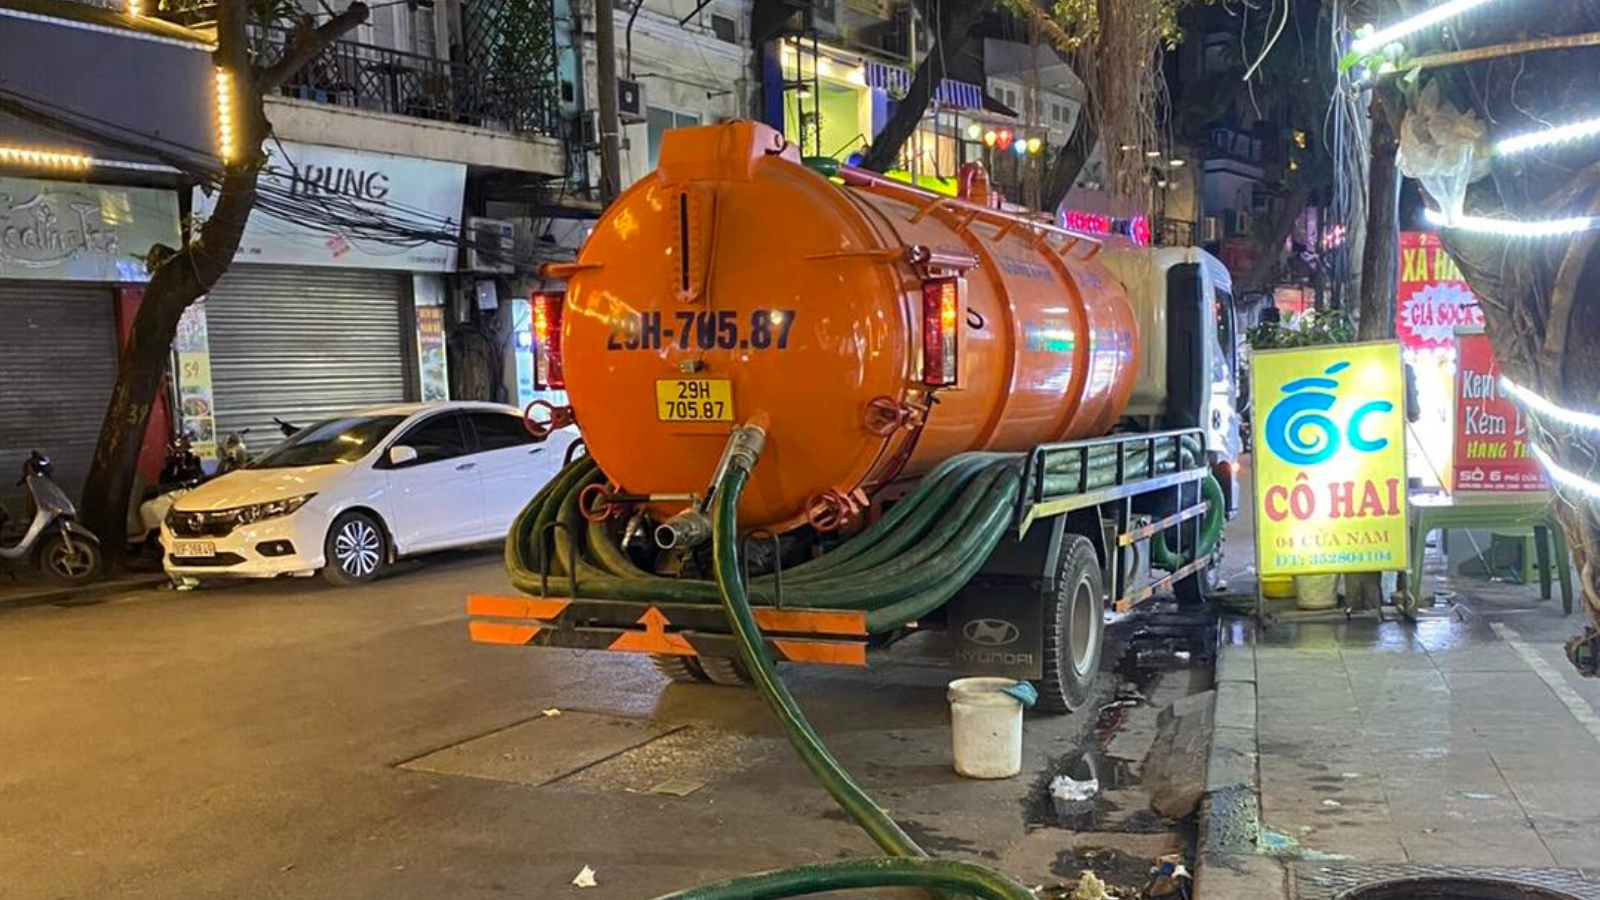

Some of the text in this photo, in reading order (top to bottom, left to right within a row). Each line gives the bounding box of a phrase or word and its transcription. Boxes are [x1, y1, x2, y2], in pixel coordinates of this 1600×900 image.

[1411, 295, 1433, 325] GIÁ
[676, 381, 711, 399] 29H
[665, 401, 725, 419] 705.87
[1265, 361, 1394, 465] ỐC
[1465, 405, 1506, 435] Kem
[1489, 471, 1501, 482] 6
[1264, 472, 1400, 522] CÔ HAI
[1346, 530, 1390, 546] NAM
[955, 649, 1034, 665] HYUNDAI
